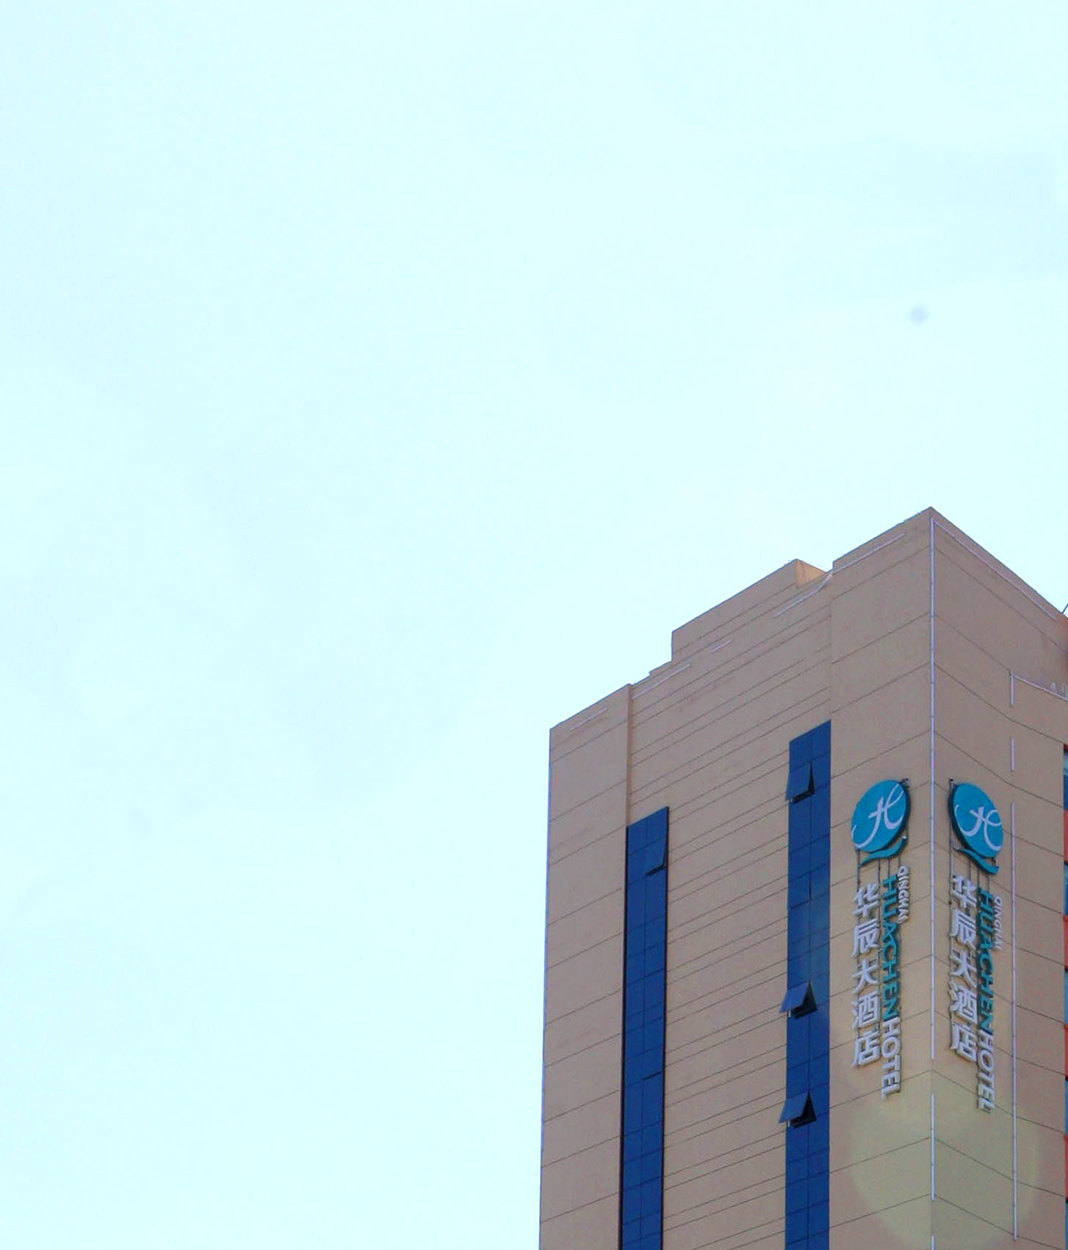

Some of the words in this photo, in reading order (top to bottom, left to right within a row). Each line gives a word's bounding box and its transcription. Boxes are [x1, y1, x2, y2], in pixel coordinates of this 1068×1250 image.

[898, 865, 910, 924] QINGHAI
[851, 882, 882, 1069] 华辰大酒店
[950, 874, 978, 1064] 华辰大酒店
[881, 1017, 901, 1100] HOTEL
